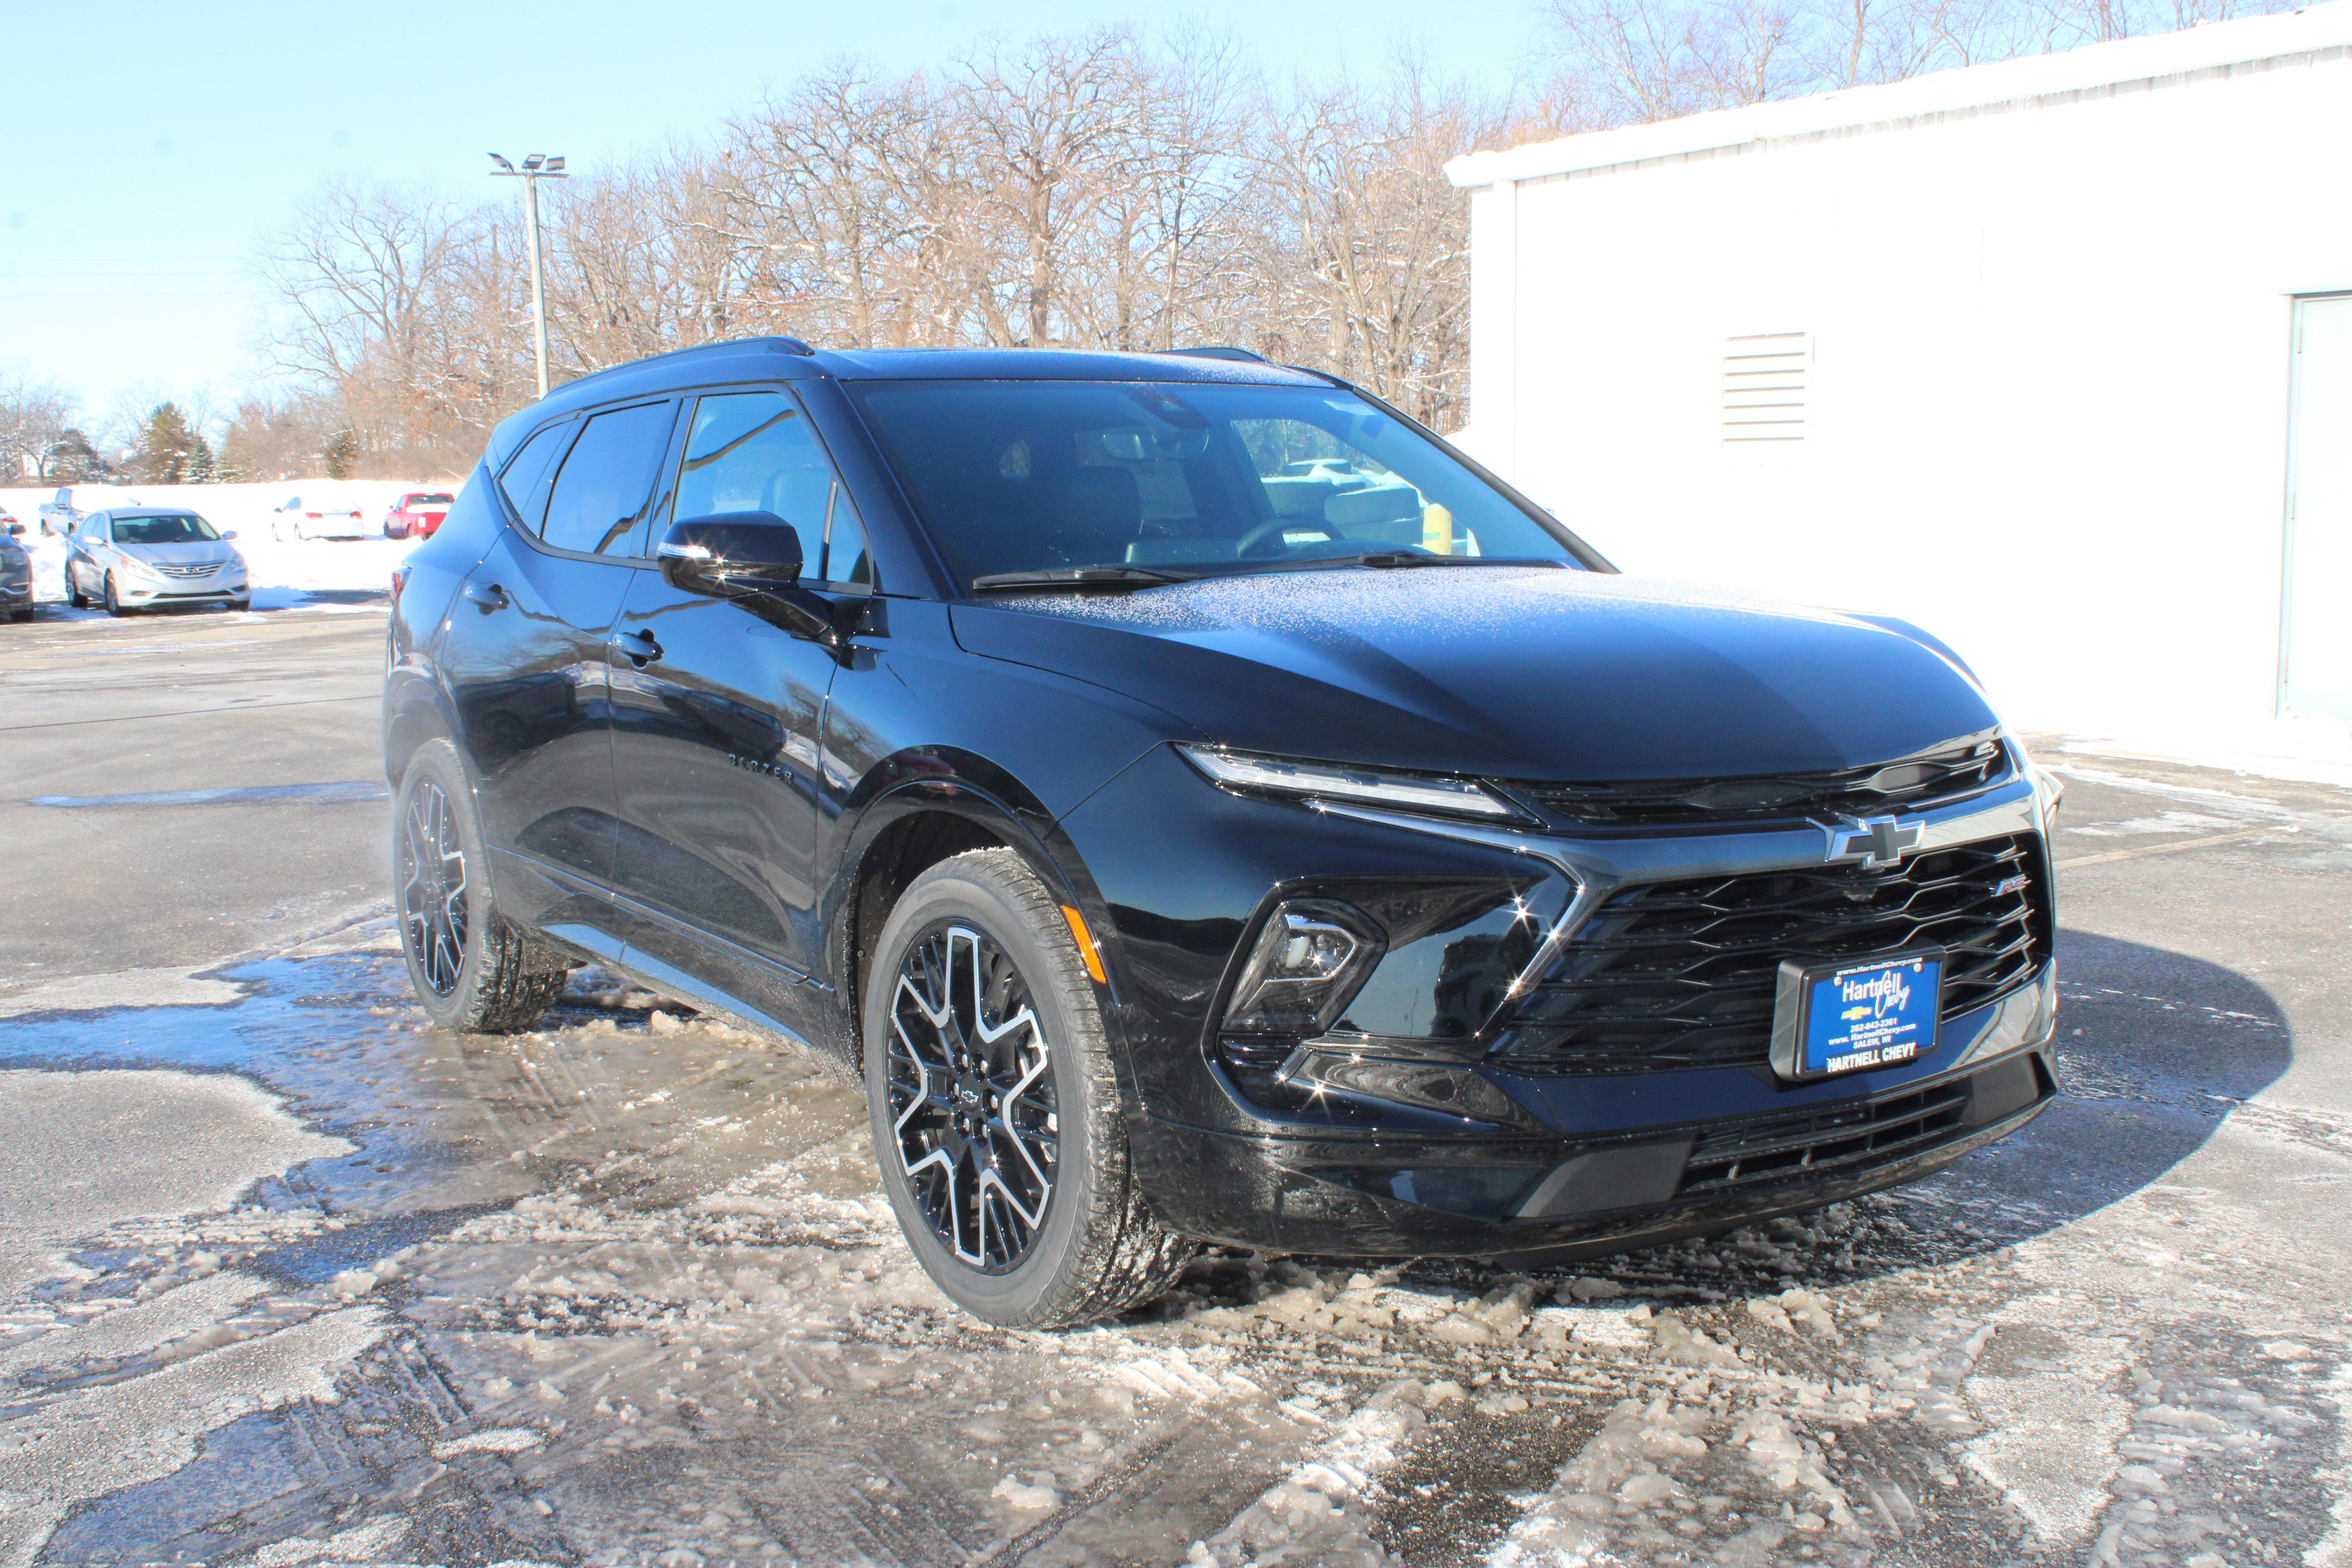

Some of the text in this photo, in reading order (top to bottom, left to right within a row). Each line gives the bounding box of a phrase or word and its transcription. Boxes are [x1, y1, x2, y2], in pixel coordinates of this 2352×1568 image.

[1836, 957, 1923, 976] www.HartnellChevy.com
[1842, 972, 1902, 1002] Hartnell
[1875, 970, 1911, 1019] Chevy
[1850, 1017, 1898, 1033] 262-843-2361
[1851, 1023, 1916, 1041] HartnellChevy.com
[1853, 1035, 1892, 1049] SALEM, WI
[1826, 1042, 1917, 1073] HARTNELL CHEVY
